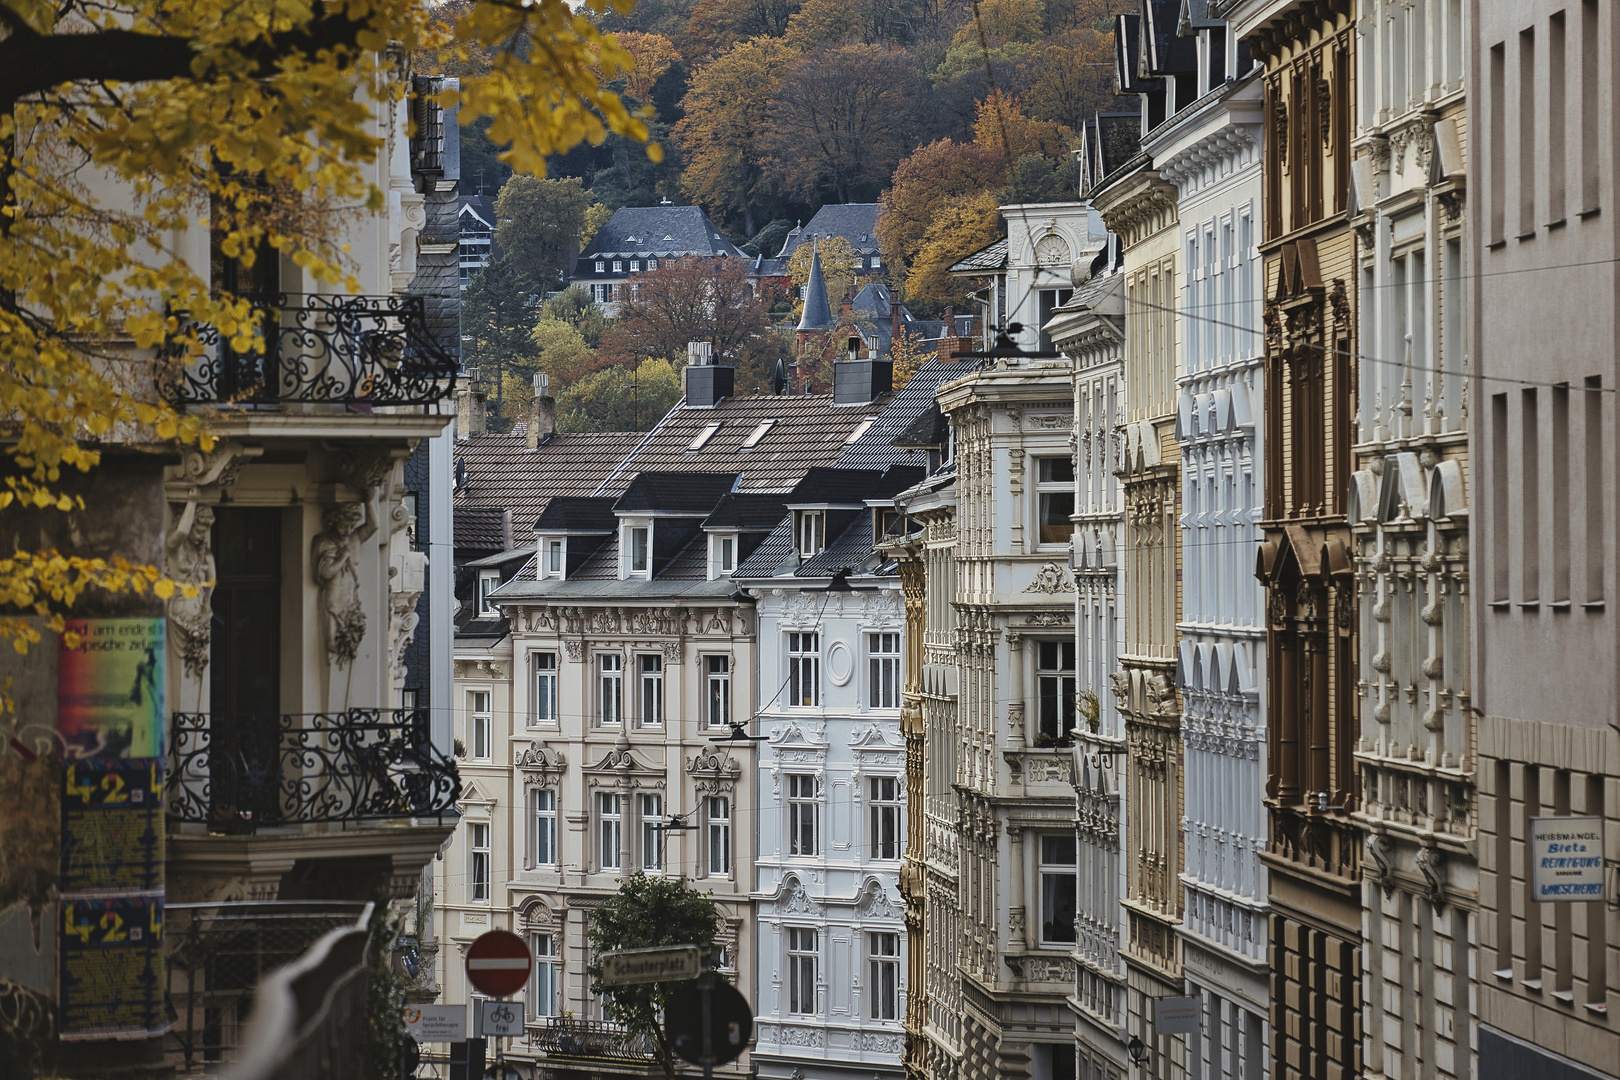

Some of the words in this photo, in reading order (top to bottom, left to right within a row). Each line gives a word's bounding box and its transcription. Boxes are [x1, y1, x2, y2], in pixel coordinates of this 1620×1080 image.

[66, 764, 128, 803] 42
[1536, 833, 1601, 841] HEISSMANGEL
[1540, 856, 1602, 869] REINIGUNG
[1541, 883, 1604, 896] WAESCHEREI
[65, 903, 128, 942] 42
[613, 956, 686, 977] Schusterplatz
[495, 1024, 510, 1032] frei
